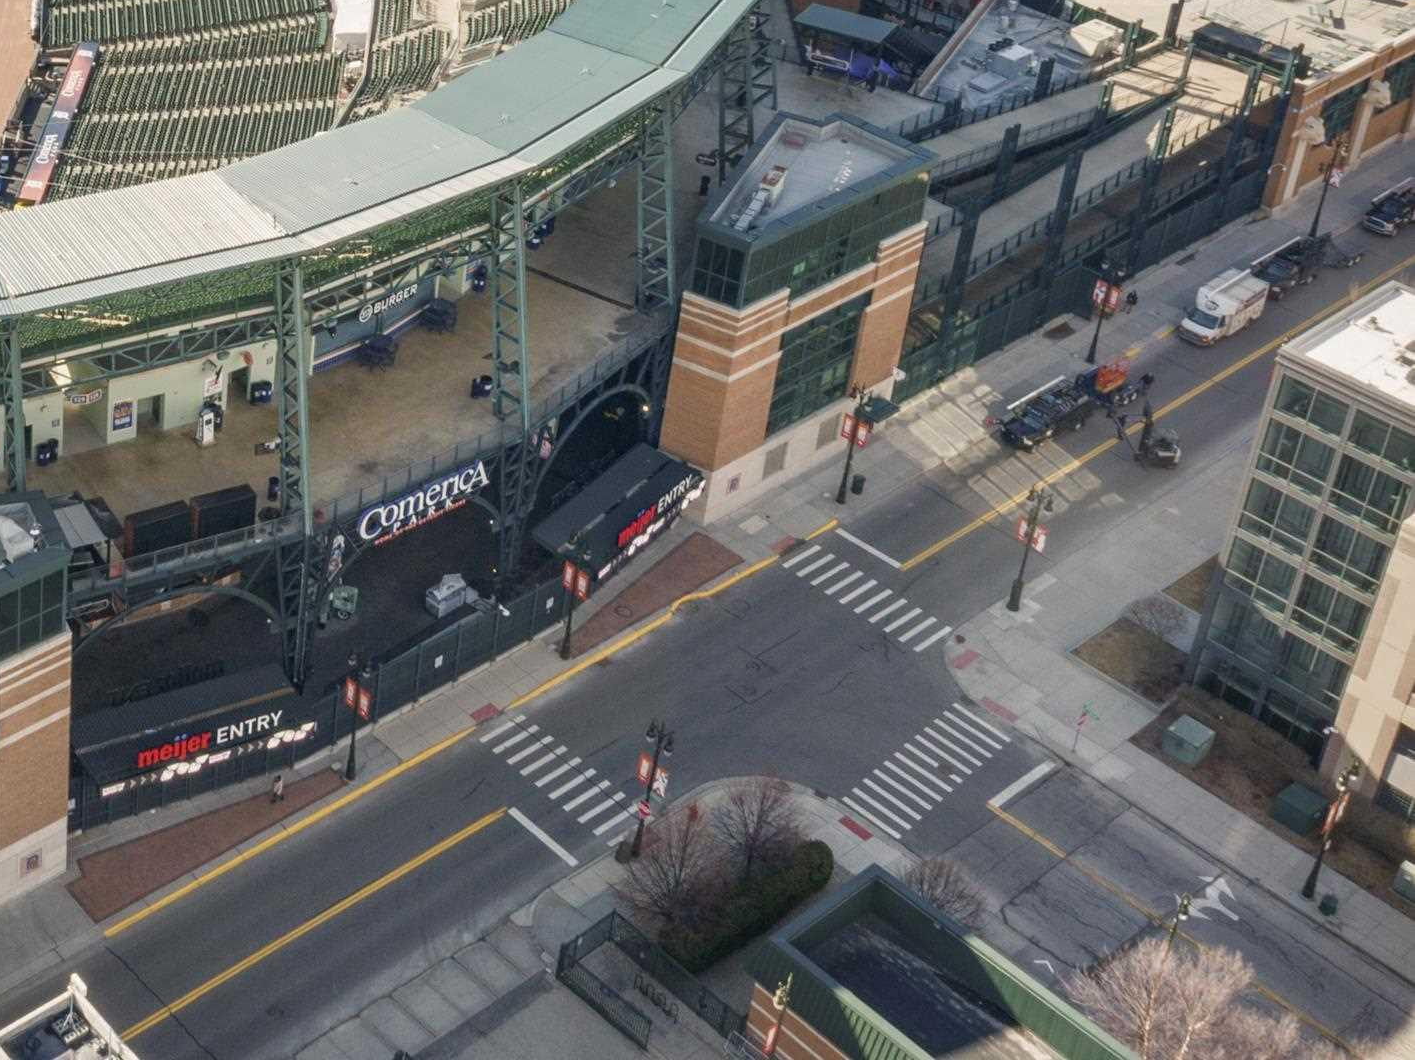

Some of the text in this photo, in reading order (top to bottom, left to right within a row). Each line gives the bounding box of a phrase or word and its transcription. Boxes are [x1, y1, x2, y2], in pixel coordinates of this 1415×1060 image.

[373, 284, 418, 314] BURGER
[617, 473, 693, 548] meijer ENTRY
[137, 709, 283, 770] meijer ENTRY
